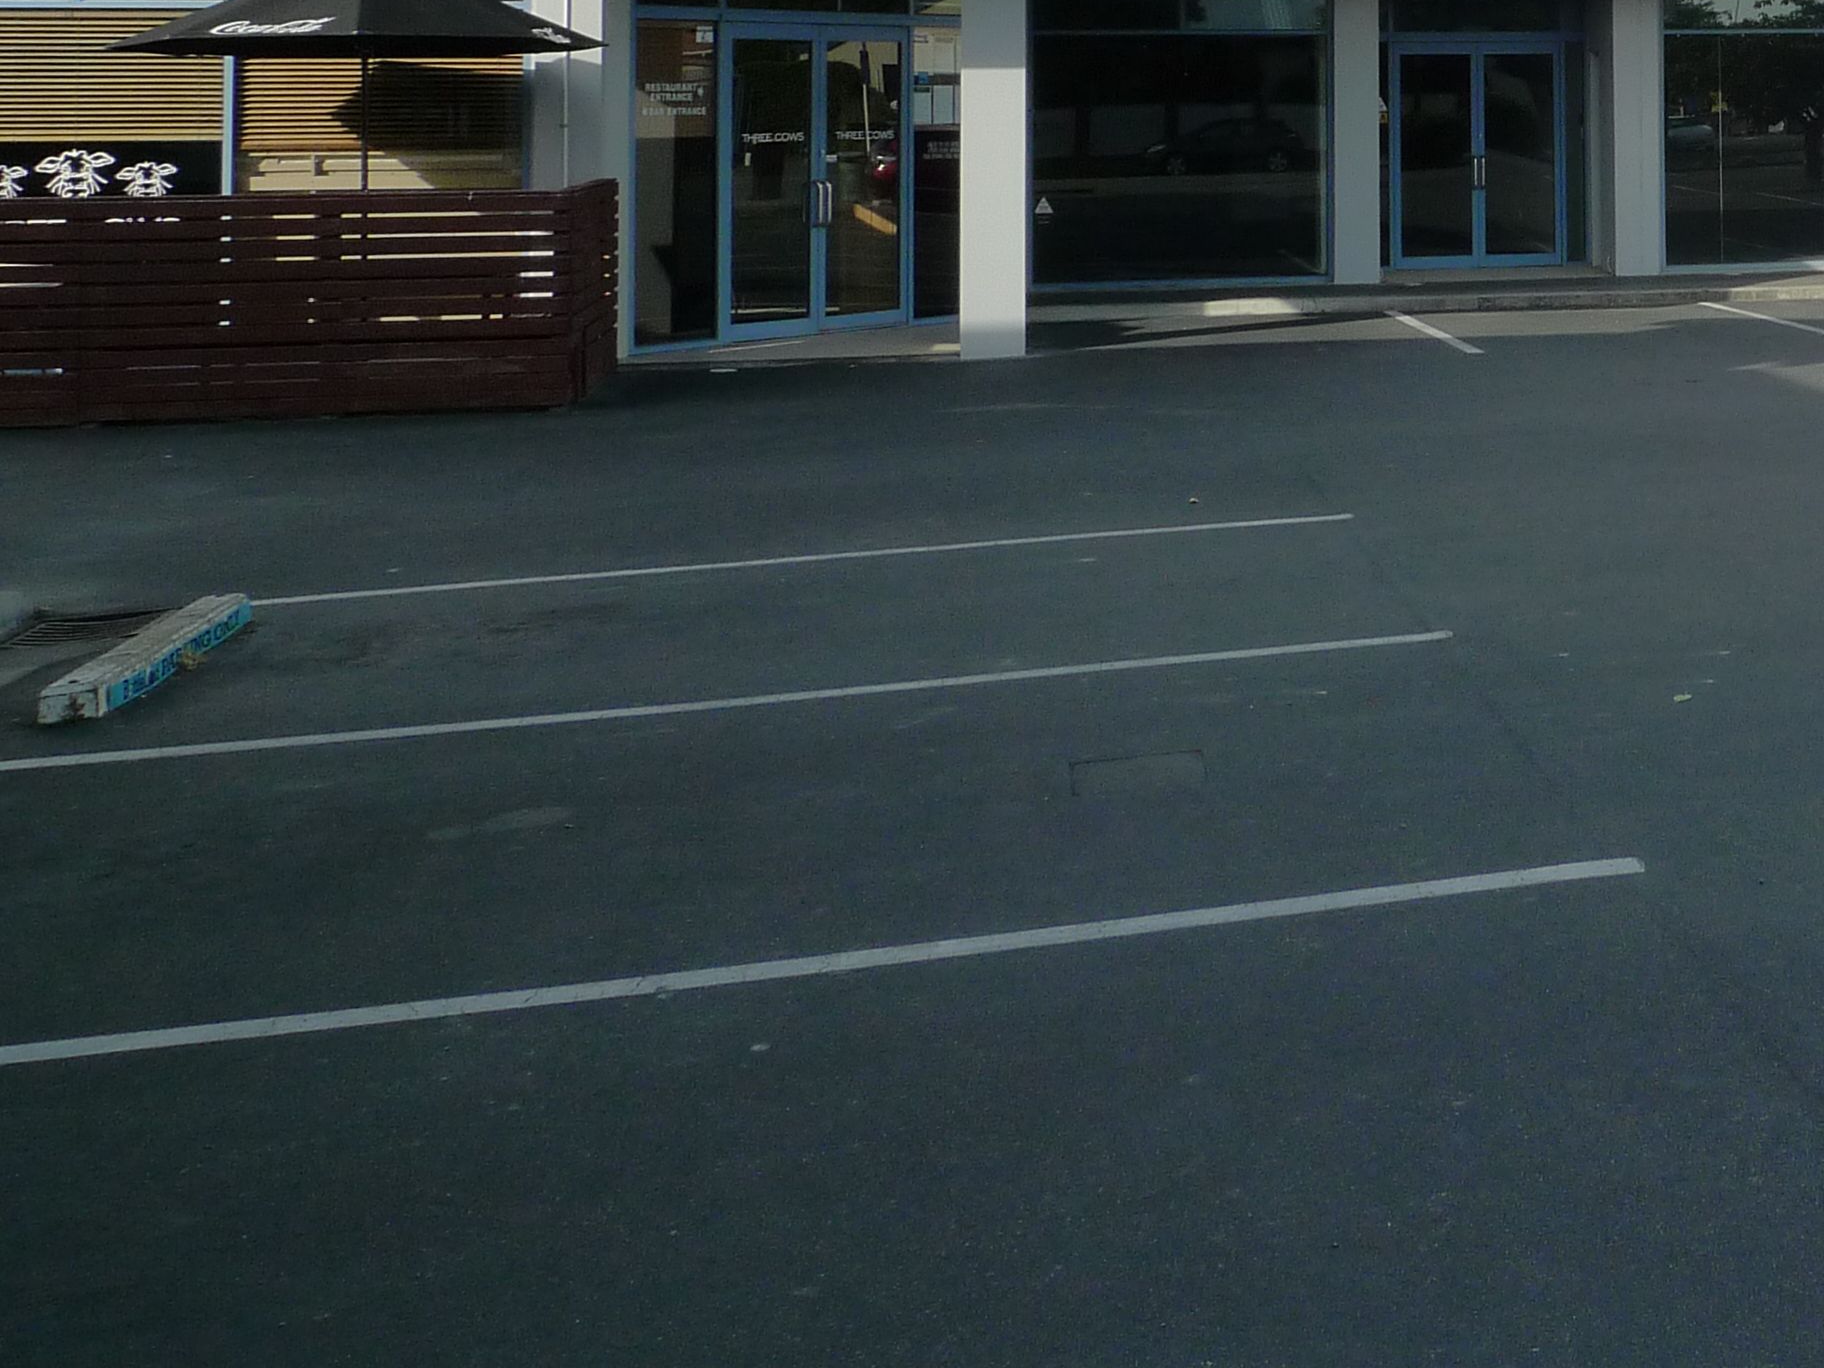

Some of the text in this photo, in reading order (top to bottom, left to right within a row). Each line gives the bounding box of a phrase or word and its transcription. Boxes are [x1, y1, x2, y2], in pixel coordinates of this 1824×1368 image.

[742, 132, 804, 143] THREE COWS
[836, 130, 895, 140] THREE COWS
